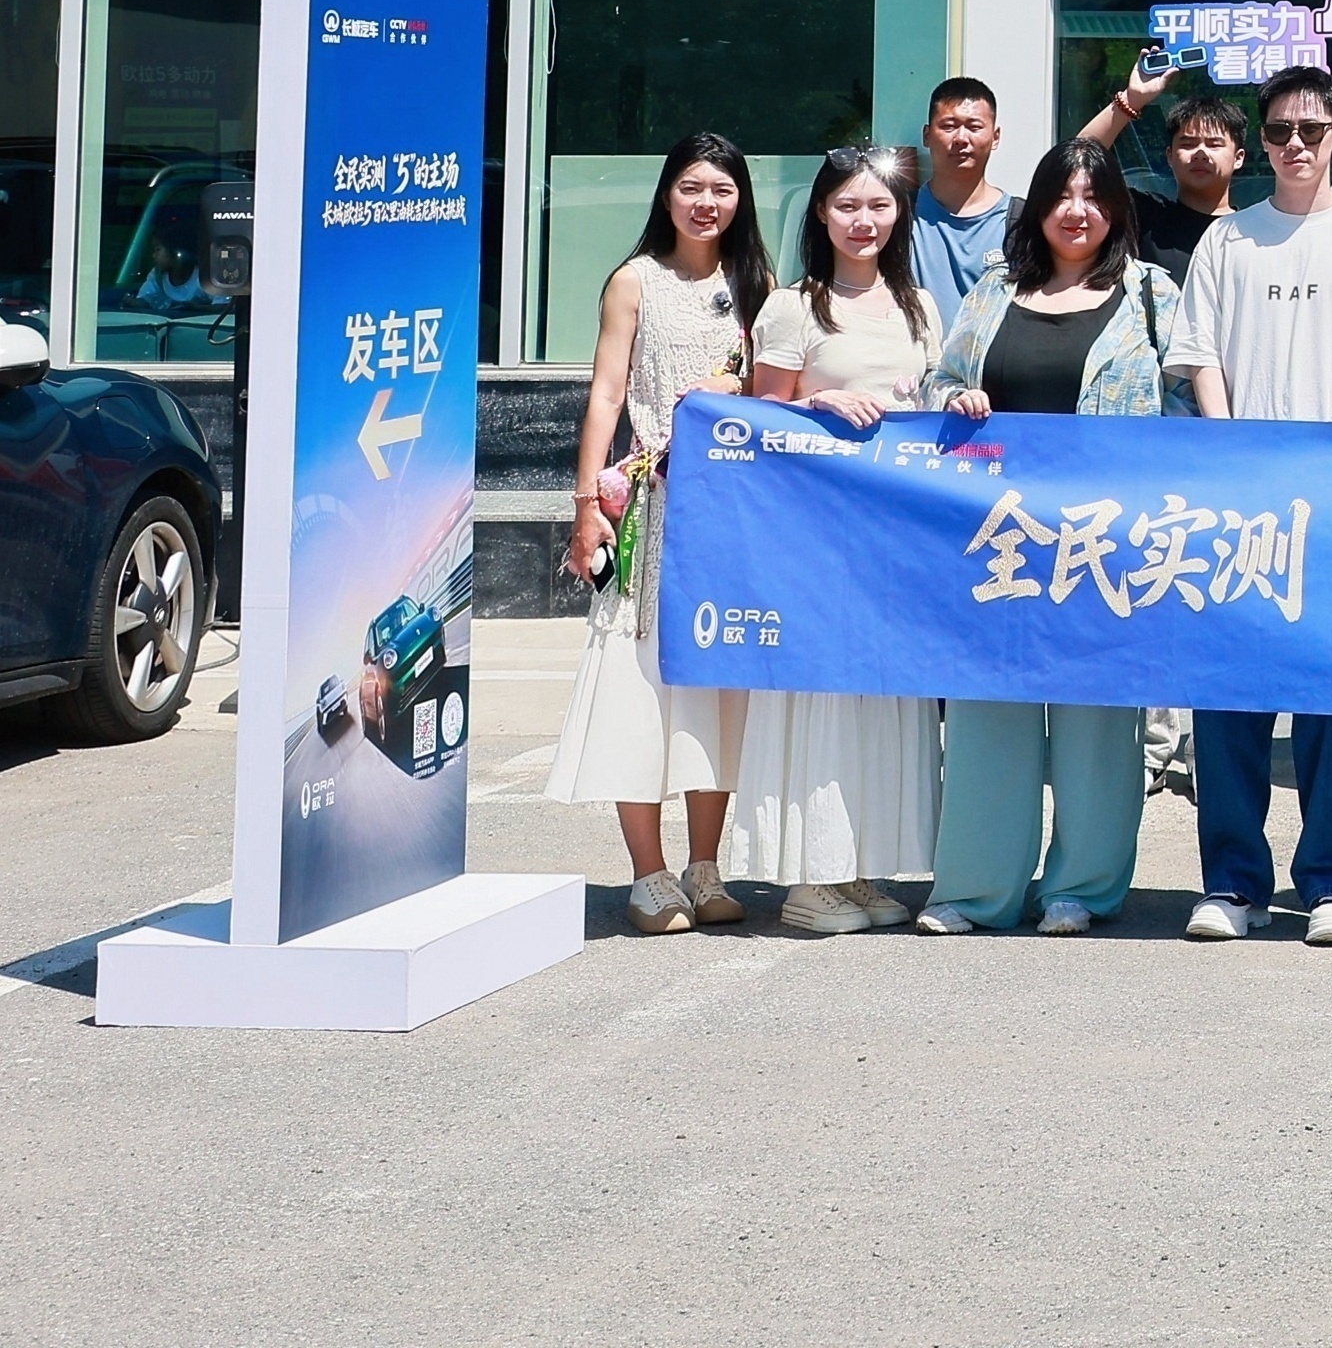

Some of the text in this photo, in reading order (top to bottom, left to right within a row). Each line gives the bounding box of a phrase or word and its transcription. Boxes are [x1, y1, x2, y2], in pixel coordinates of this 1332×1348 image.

[341, 19, 379, 39] 长城汽车
[1153, 6, 1306, 44] 平顺实力
[334, 154, 386, 193] 全民实测
[213, 212, 254, 220] HAVAL
[322, 195, 466, 228] 长城欧拉5百公里油耗吉尼斯大挑战
[342, 308, 444, 384] 发车区
[760, 430, 863, 457] 长城汽车
[897, 441, 944, 456] CCTV
[707, 448, 755, 462] GWM
[894, 455, 1003, 476] 合作伙伴
[963, 489, 1310, 624] 全民实测
[724, 608, 781, 624] ORA
[722, 626, 781, 647] 欧拉
[312, 777, 336, 791] ORA
[311, 791, 336, 812] 欧拉
